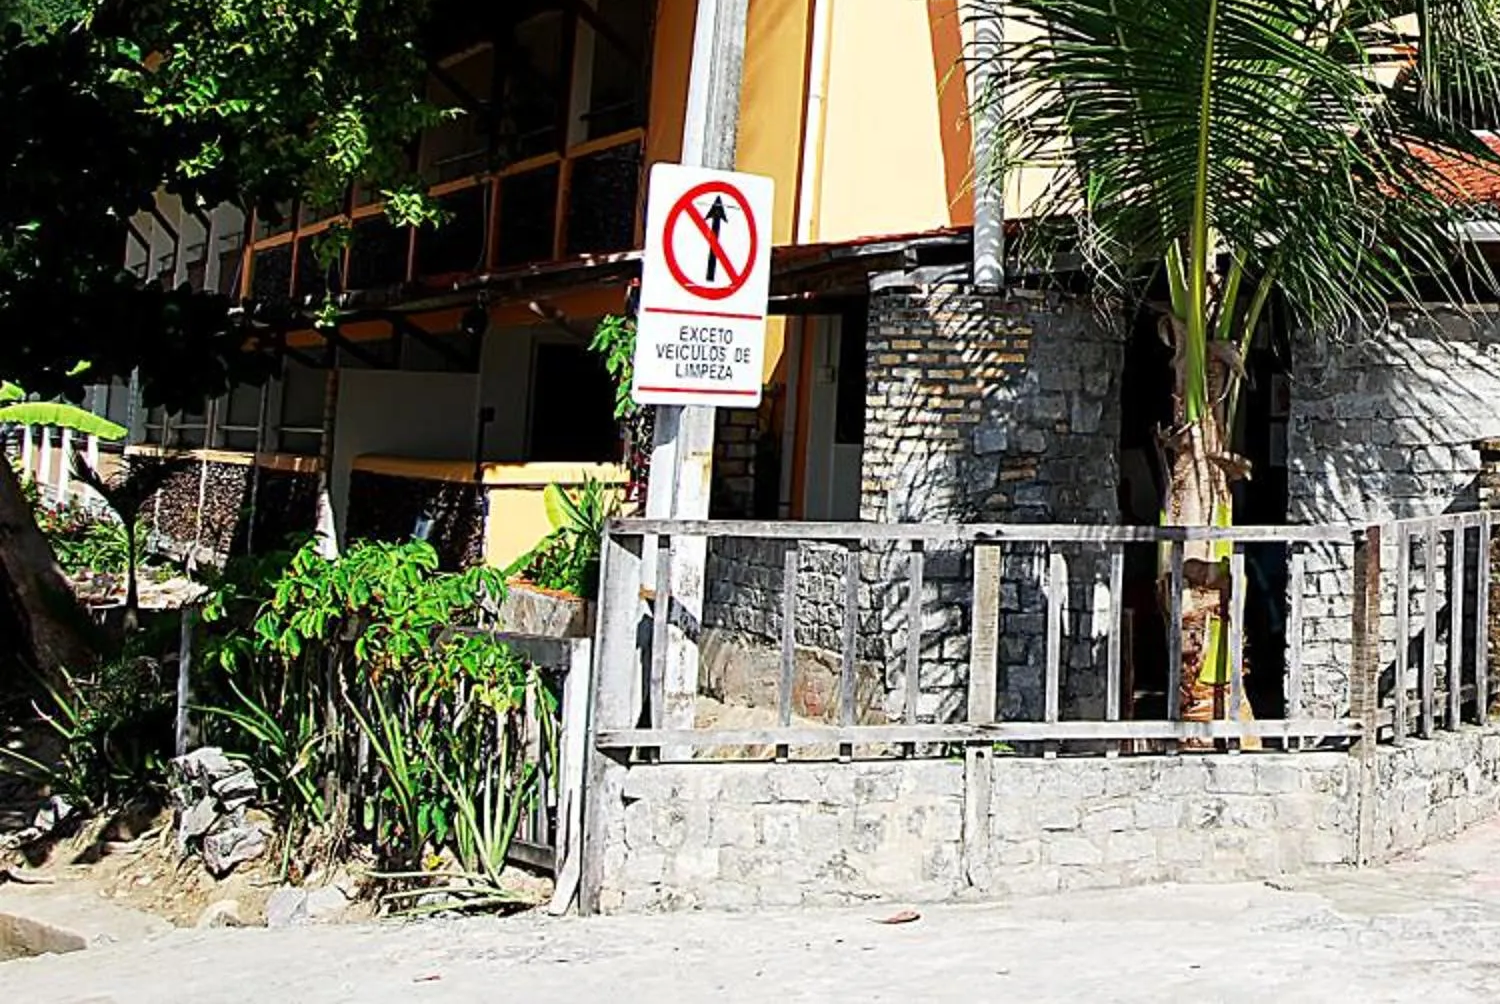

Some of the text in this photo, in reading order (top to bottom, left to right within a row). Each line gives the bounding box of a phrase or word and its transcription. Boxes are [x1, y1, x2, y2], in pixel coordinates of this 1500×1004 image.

[679, 325, 733, 344] EXCETO
[656, 343, 751, 364] VEICULOS DE
[675, 363, 734, 380] LIMPEZA
